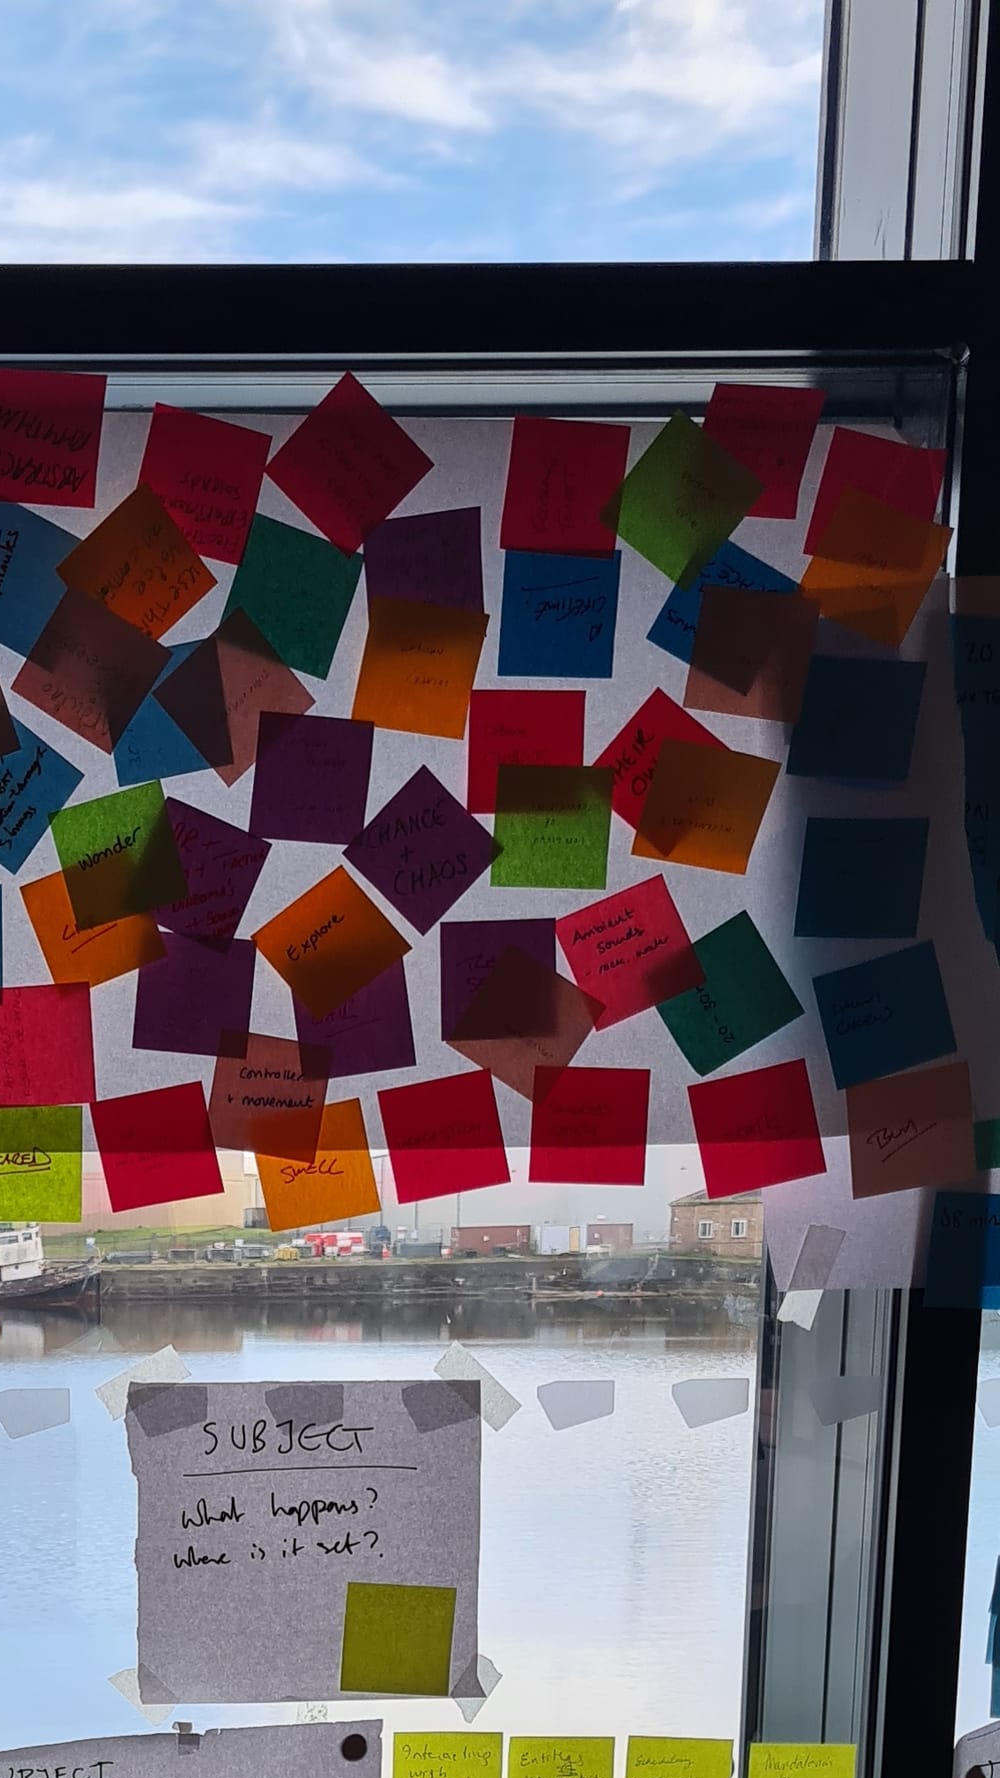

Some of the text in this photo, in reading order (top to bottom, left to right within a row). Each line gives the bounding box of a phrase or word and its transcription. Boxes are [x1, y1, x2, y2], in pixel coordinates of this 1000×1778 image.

[75, 825, 144, 874] Wonder
[391, 850, 469, 897] CHAOS
[284, 911, 346, 963] Explore
[201, 1418, 376, 1456] SUBJECT
[270, 1486, 380, 1527] happens?
[249, 1529, 385, 1561] is it set?
